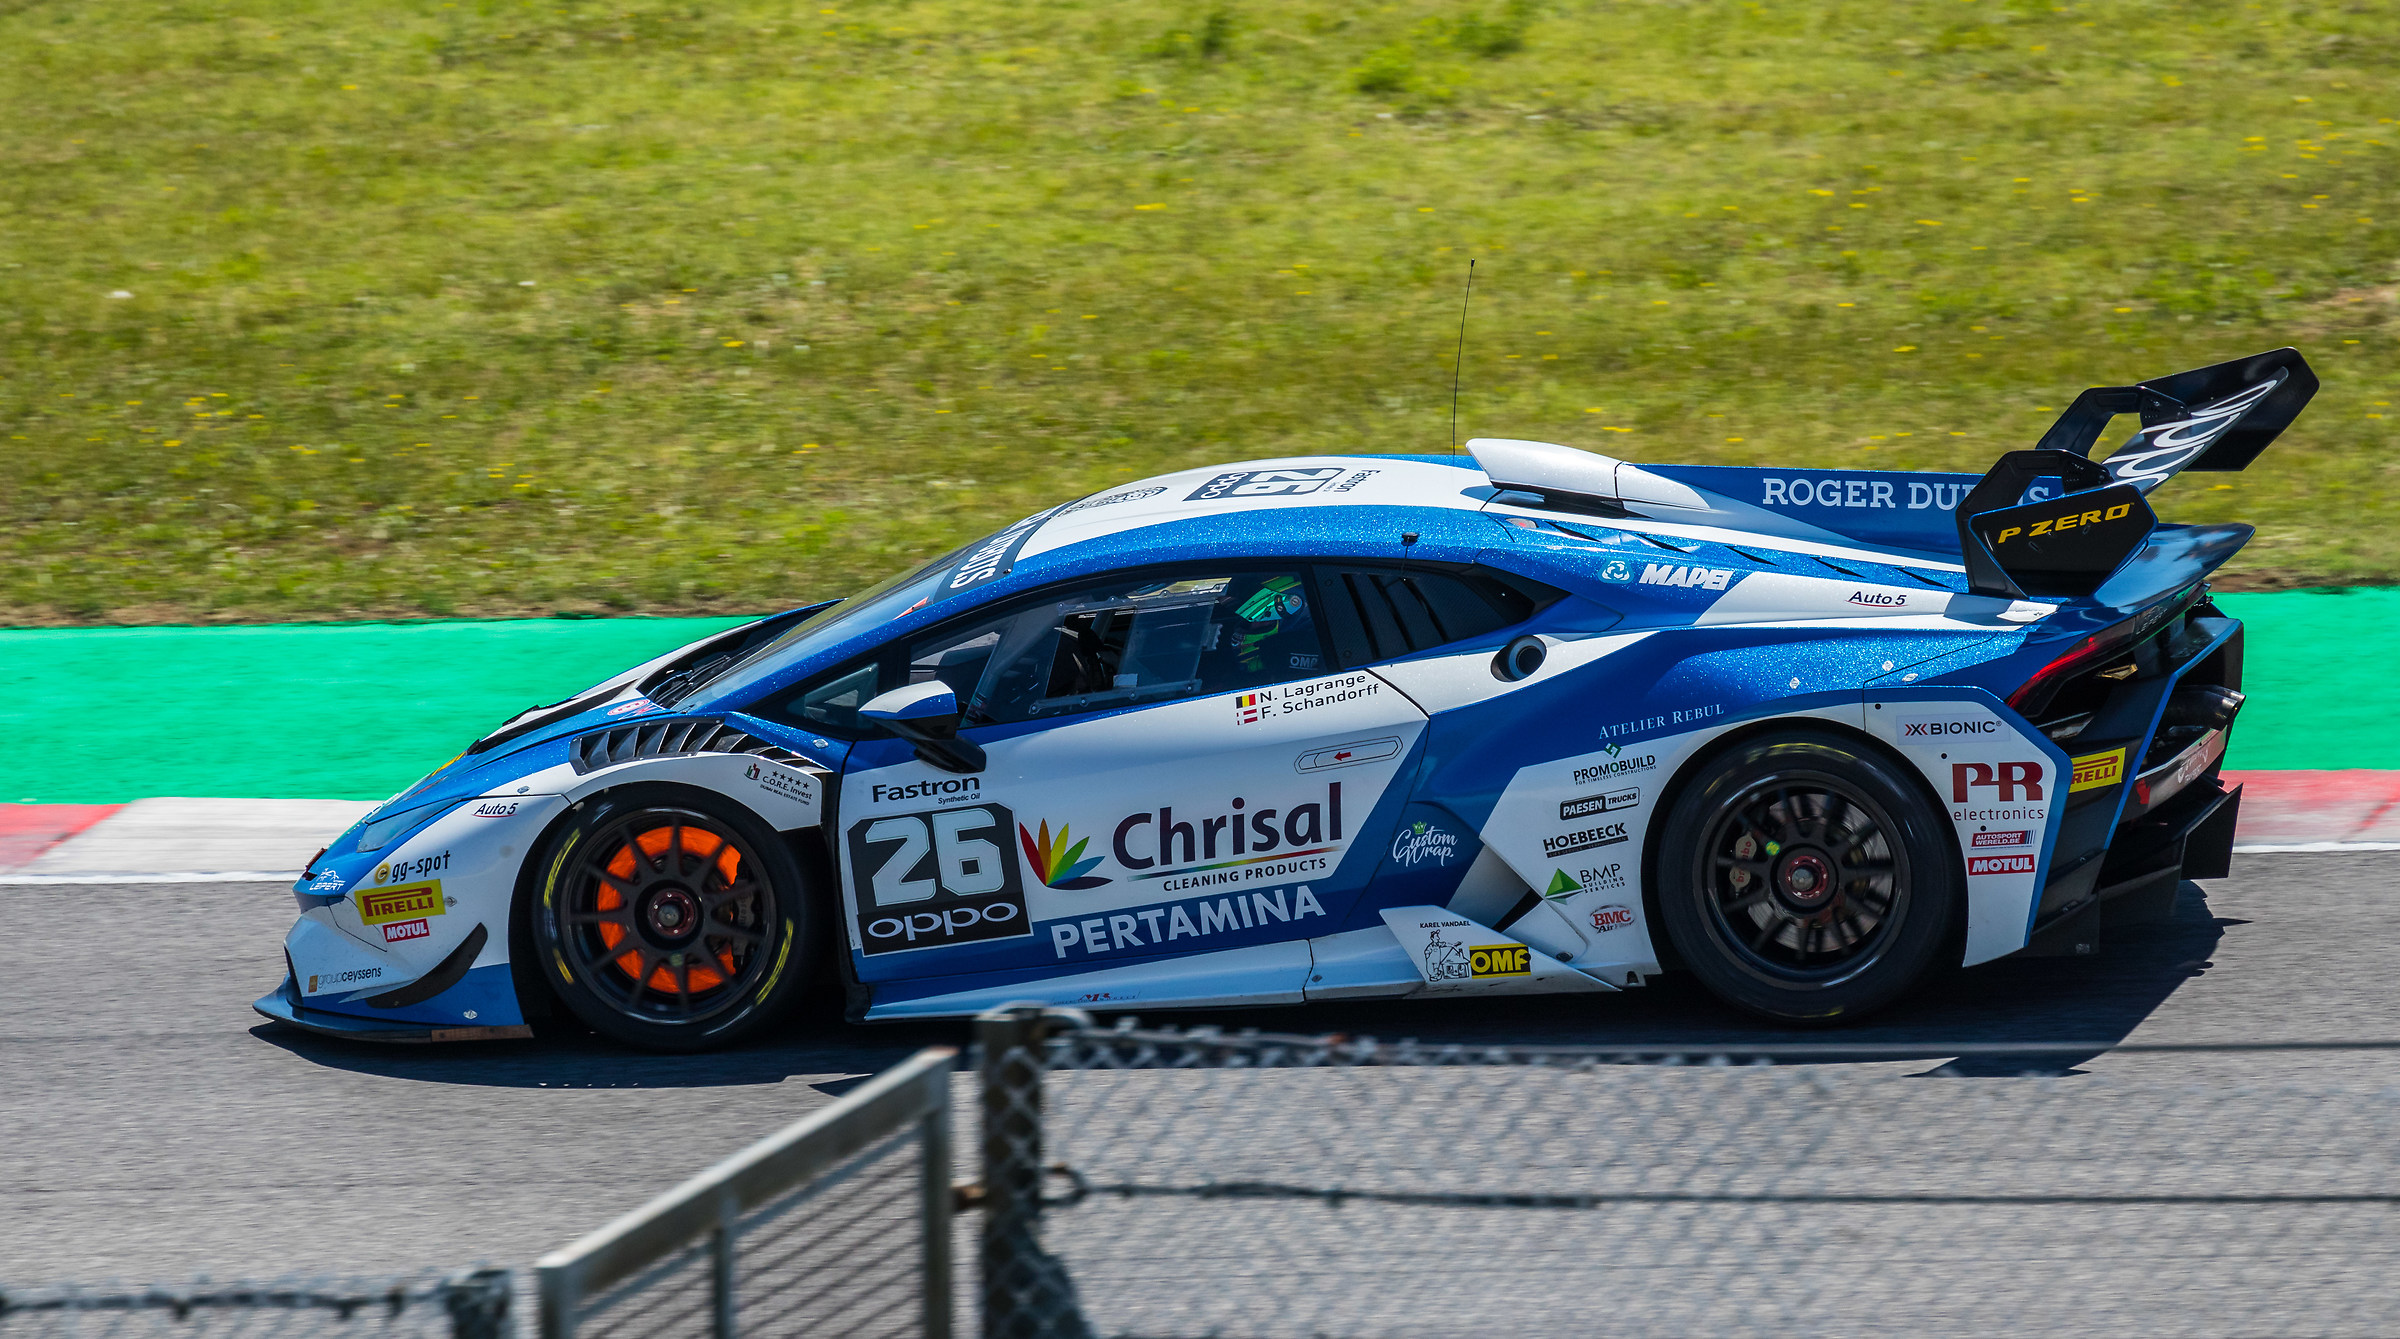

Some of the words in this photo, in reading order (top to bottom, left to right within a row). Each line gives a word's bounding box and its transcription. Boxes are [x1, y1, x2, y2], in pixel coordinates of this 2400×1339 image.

[1762, 477, 1896, 509] ROGER
[1998, 526, 2022, 544] P
[2029, 503, 2131, 537] ZERO
[1638, 563, 1734, 591] MAPEI
[1848, 590, 1894, 606] Auto
[1895, 593, 1908, 607] 5
[1259, 690, 1278, 703] N.
[1284, 674, 1366, 697] Lagrange
[1261, 706, 1277, 719] F.
[1282, 683, 1380, 715] Schandorff
[1598, 715, 1667, 740] ATELIER
[1671, 703, 1725, 724] REBUL
[1573, 754, 1656, 782] PROMOBUILD
[1952, 761, 2044, 803] PR
[762, 775, 789, 792] C.O.R.E.
[790, 785, 813, 800] Invest
[872, 776, 980, 803] Fastron
[937, 794, 969, 805] Synthetic
[970, 792, 981, 801] Oil
[474, 803, 507, 815] Auto
[507, 802, 519, 815] 5
[1563, 799, 1603, 816] PAESEN
[1607, 792, 1637, 805] TRUCKS
[1953, 806, 2045, 821] electronics
[1112, 781, 1343, 871] Chrisal
[1543, 822, 1627, 852] HOEBEECK
[1975, 832, 2023, 840] AUTOSPORT
[1392, 825, 1458, 860] Custom
[391, 850, 451, 884] gg-spot
[865, 808, 1005, 907] 26
[1971, 857, 2033, 873] MOTUL
[1162, 871, 1240, 893] CLEANING
[1245, 857, 1328, 881] PRODUCTS
[1579, 863, 1621, 884] BMP
[1583, 876, 1624, 889] BUILDING
[1584, 881, 1626, 894] SERVICES
[362, 886, 435, 917] PIRELLI
[386, 922, 428, 940] MOTUL
[867, 902, 1019, 943] oppo
[1050, 884, 1327, 960] PERTAMINA
[1419, 921, 1441, 929] KAREL
[1441, 920, 1471, 928] VANDAEL
[1592, 909, 1632, 927] BMC
